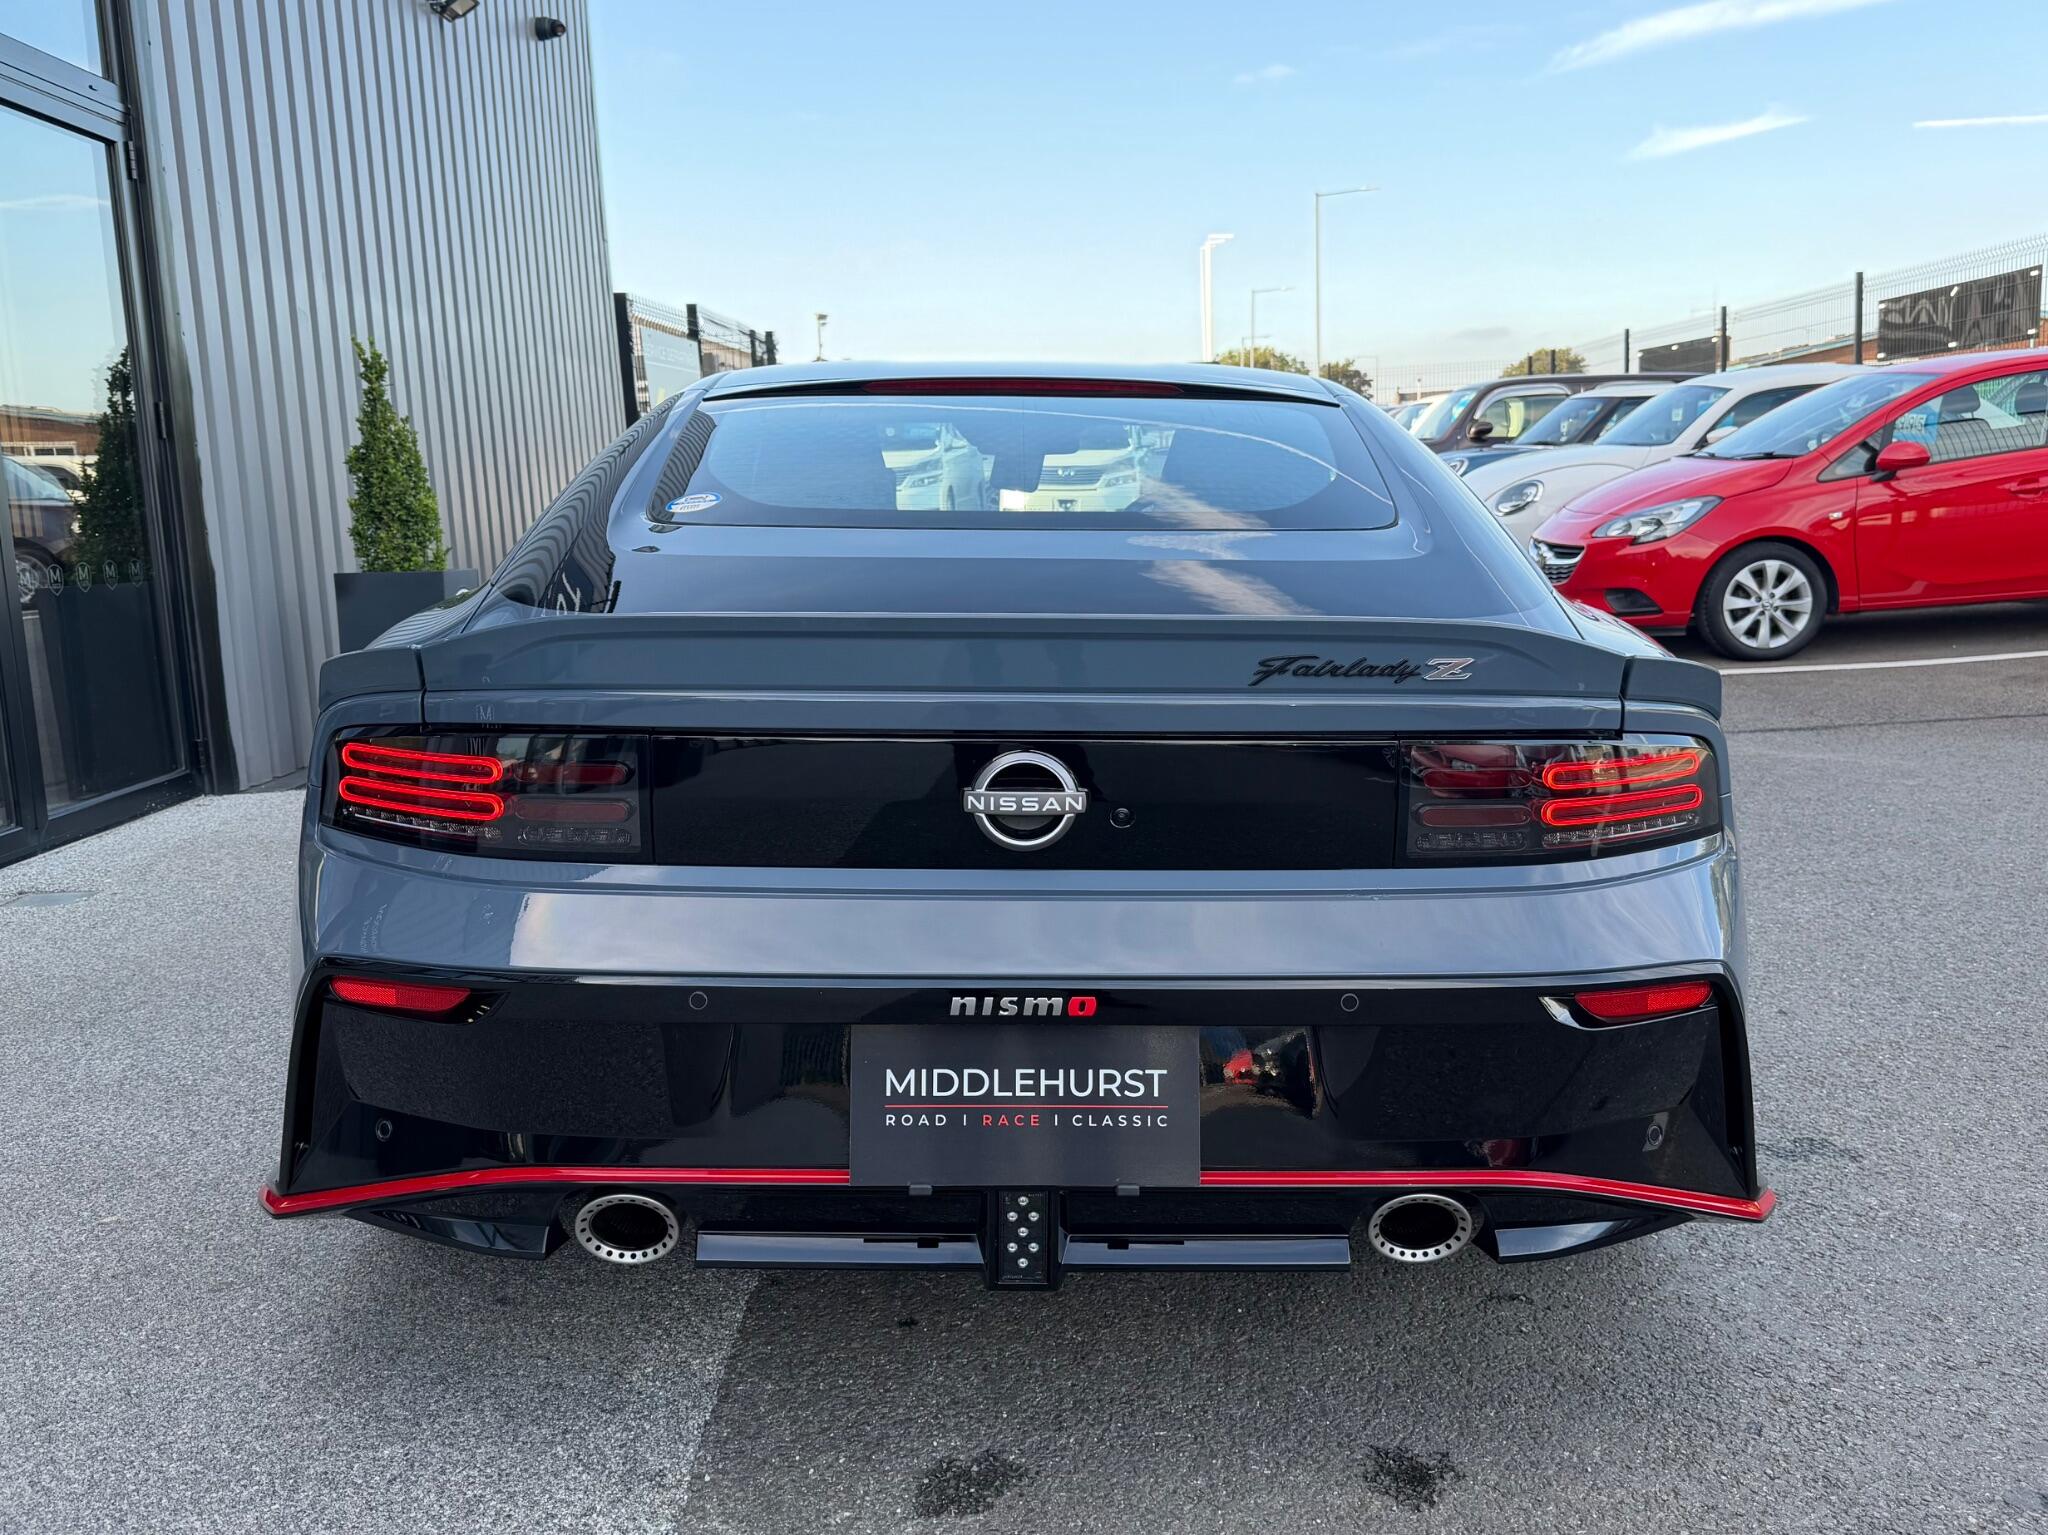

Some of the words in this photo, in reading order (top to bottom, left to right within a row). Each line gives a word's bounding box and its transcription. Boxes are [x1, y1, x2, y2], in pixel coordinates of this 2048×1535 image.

[1248, 655, 1422, 686] Fairlady
[1423, 657, 1475, 681] Z
[967, 795, 1083, 812] NISSAN
[950, 996, 1097, 1018] nismo
[885, 1068, 1168, 1098] MIDDLEHURST
[886, 1114, 947, 1127] ROAD
[982, 1114, 1040, 1127] RACE
[1072, 1114, 1168, 1128] CLASSIC
